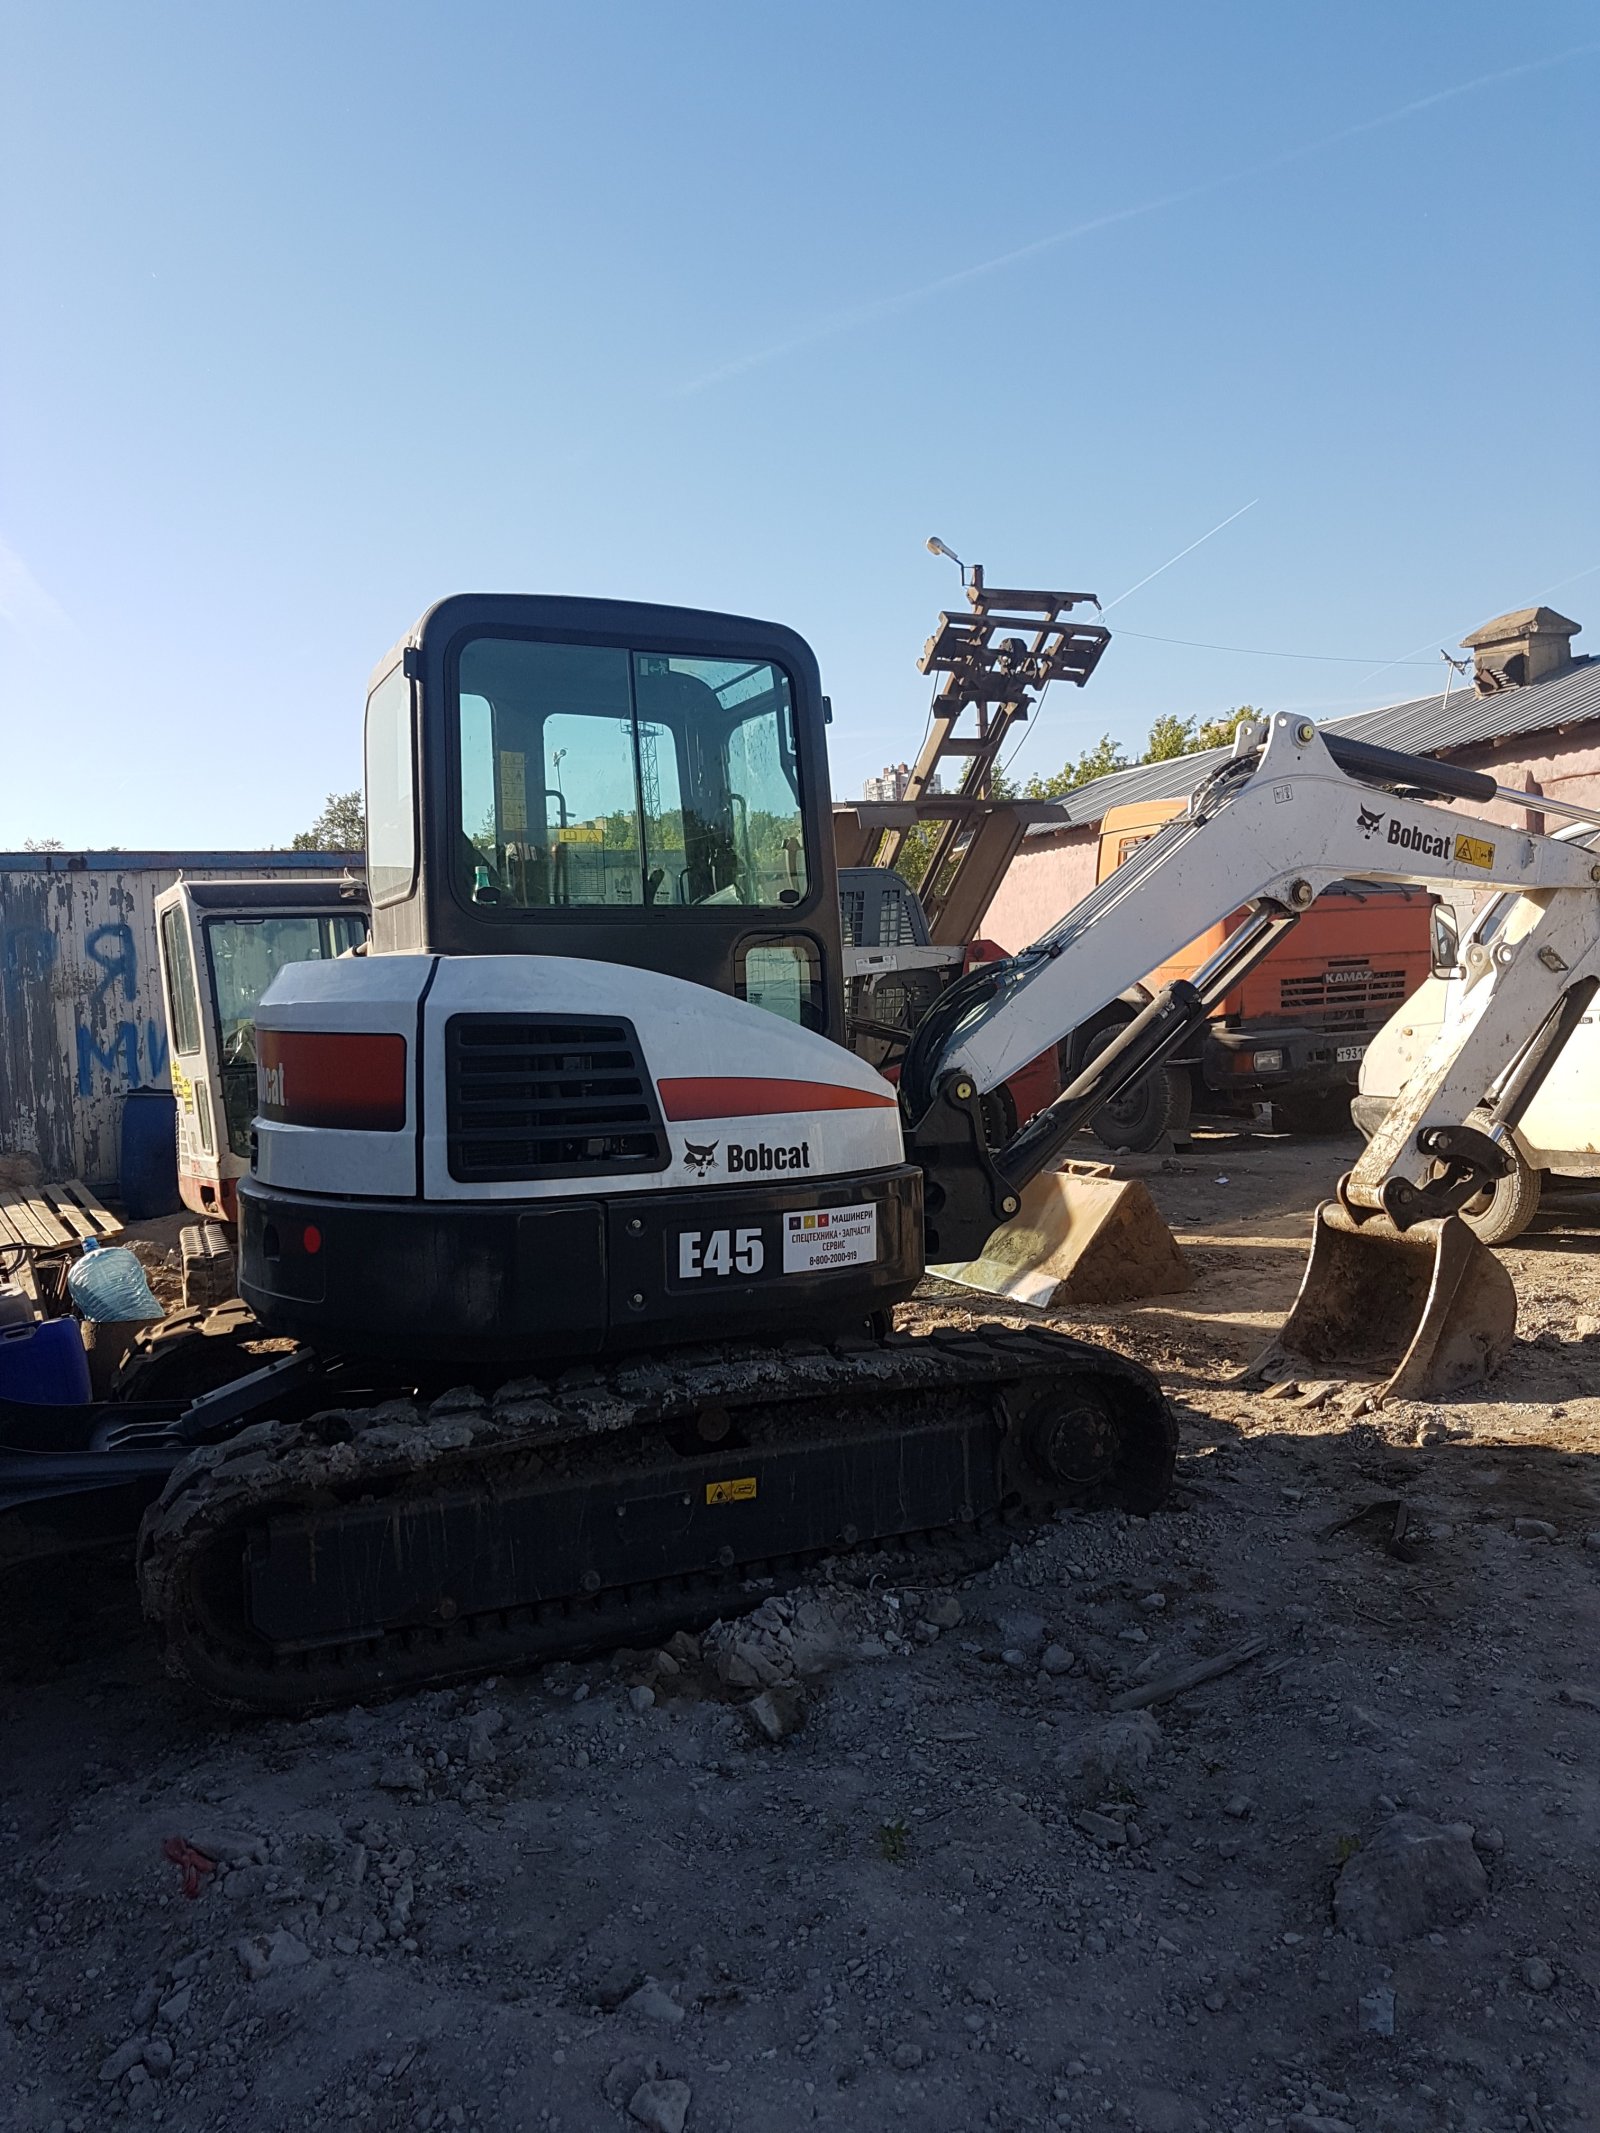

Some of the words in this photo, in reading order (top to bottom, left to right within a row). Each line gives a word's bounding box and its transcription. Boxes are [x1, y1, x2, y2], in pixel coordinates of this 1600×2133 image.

[1387, 819, 1450, 859] Bobcat
[1325, 971, 1373, 983] KAMAZ
[727, 1142, 810, 1172] Bobcat
[831, 1210, 873, 1224] МАШИНЕРИ
[792, 1230, 838, 1244] СПЕЦТЕХНИКА
[842, 1226, 871, 1238] ЗАПЧАСТИ
[679, 1228, 764, 1278] E45
[822, 1240, 846, 1251] СЕРВИС
[809, 1251, 858, 1266] 8-800-2000-919
